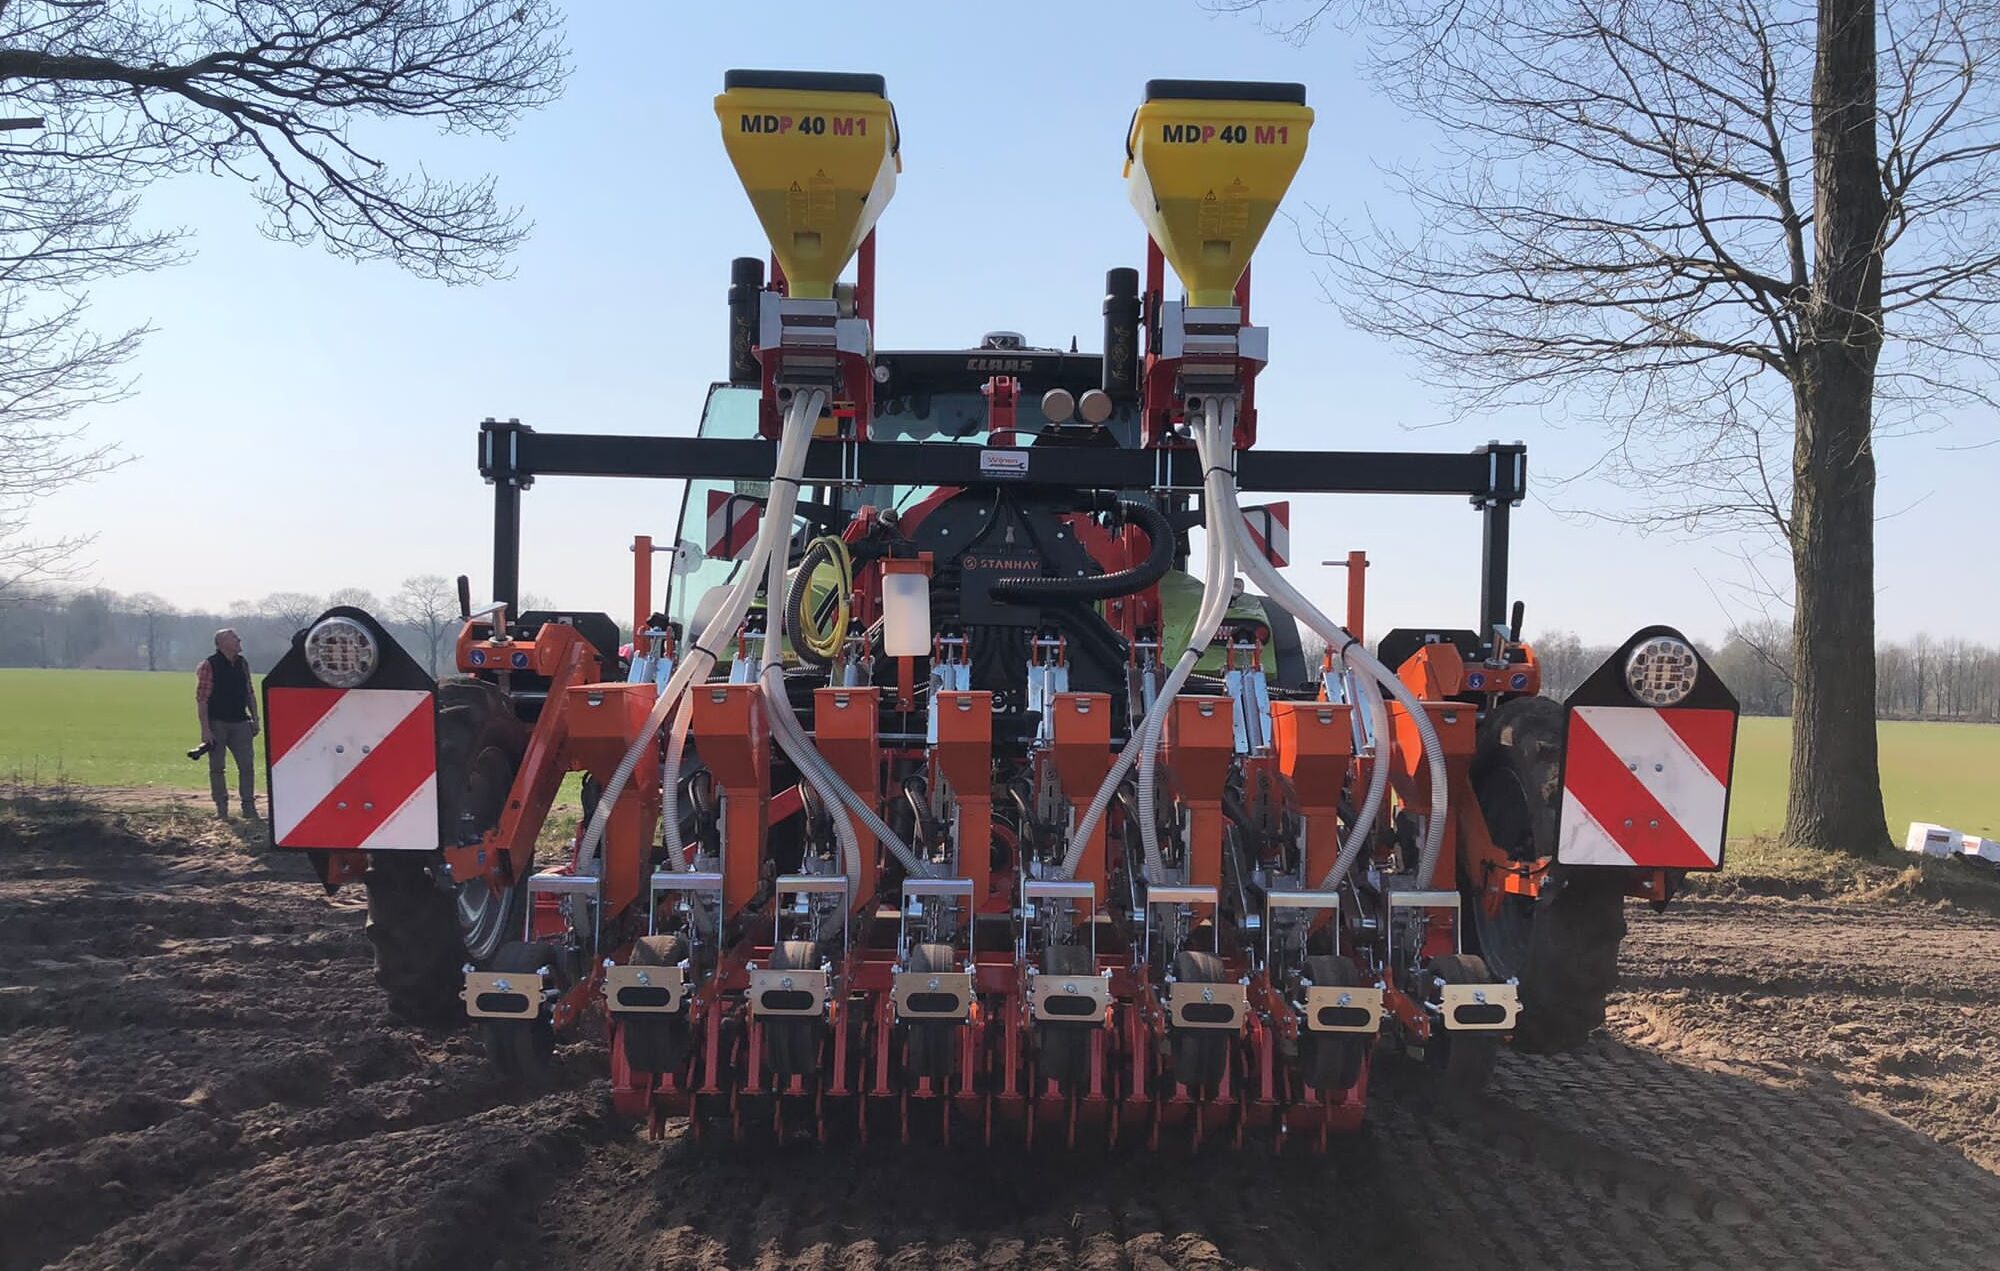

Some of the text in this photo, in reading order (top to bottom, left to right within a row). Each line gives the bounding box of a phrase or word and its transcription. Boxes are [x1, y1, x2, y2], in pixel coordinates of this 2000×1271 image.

[741, 114, 866, 136] MDP 40 M1
[1163, 125, 1288, 144] MDP 40 M1
[967, 358, 1033, 371] CLAAS
[980, 559, 1039, 570] STANHAY
